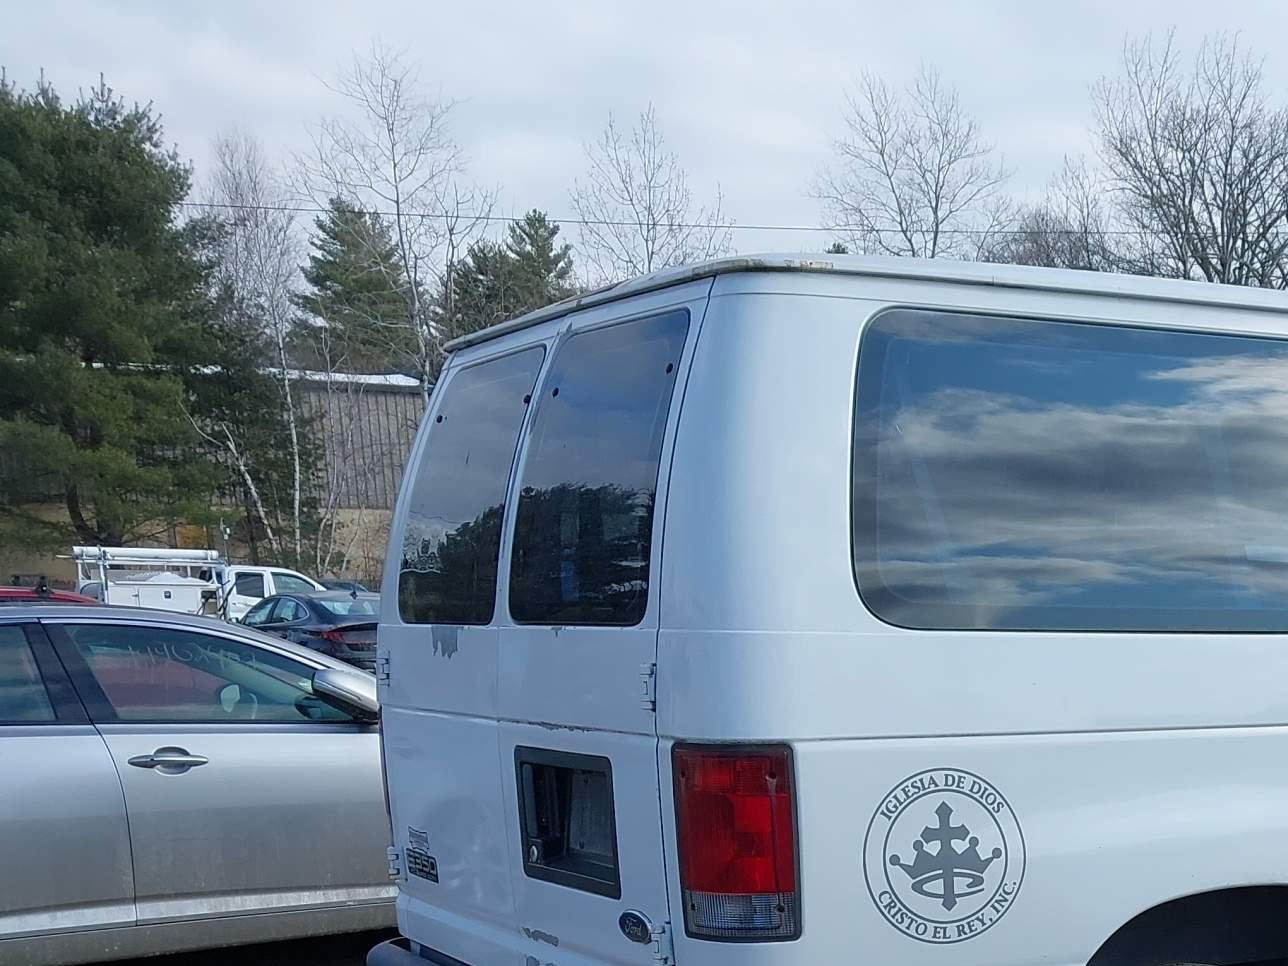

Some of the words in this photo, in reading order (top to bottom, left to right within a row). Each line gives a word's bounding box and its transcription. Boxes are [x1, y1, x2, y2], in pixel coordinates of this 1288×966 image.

[880, 775, 940, 821] IGLESIA
[943, 773, 966, 789] DE
[968, 780, 1004, 814] DIOS
[878, 890, 928, 936] CRISTO
[932, 926, 951, 939] EL
[956, 913, 993, 938] REY,
[990, 881, 1017, 915] INC.
